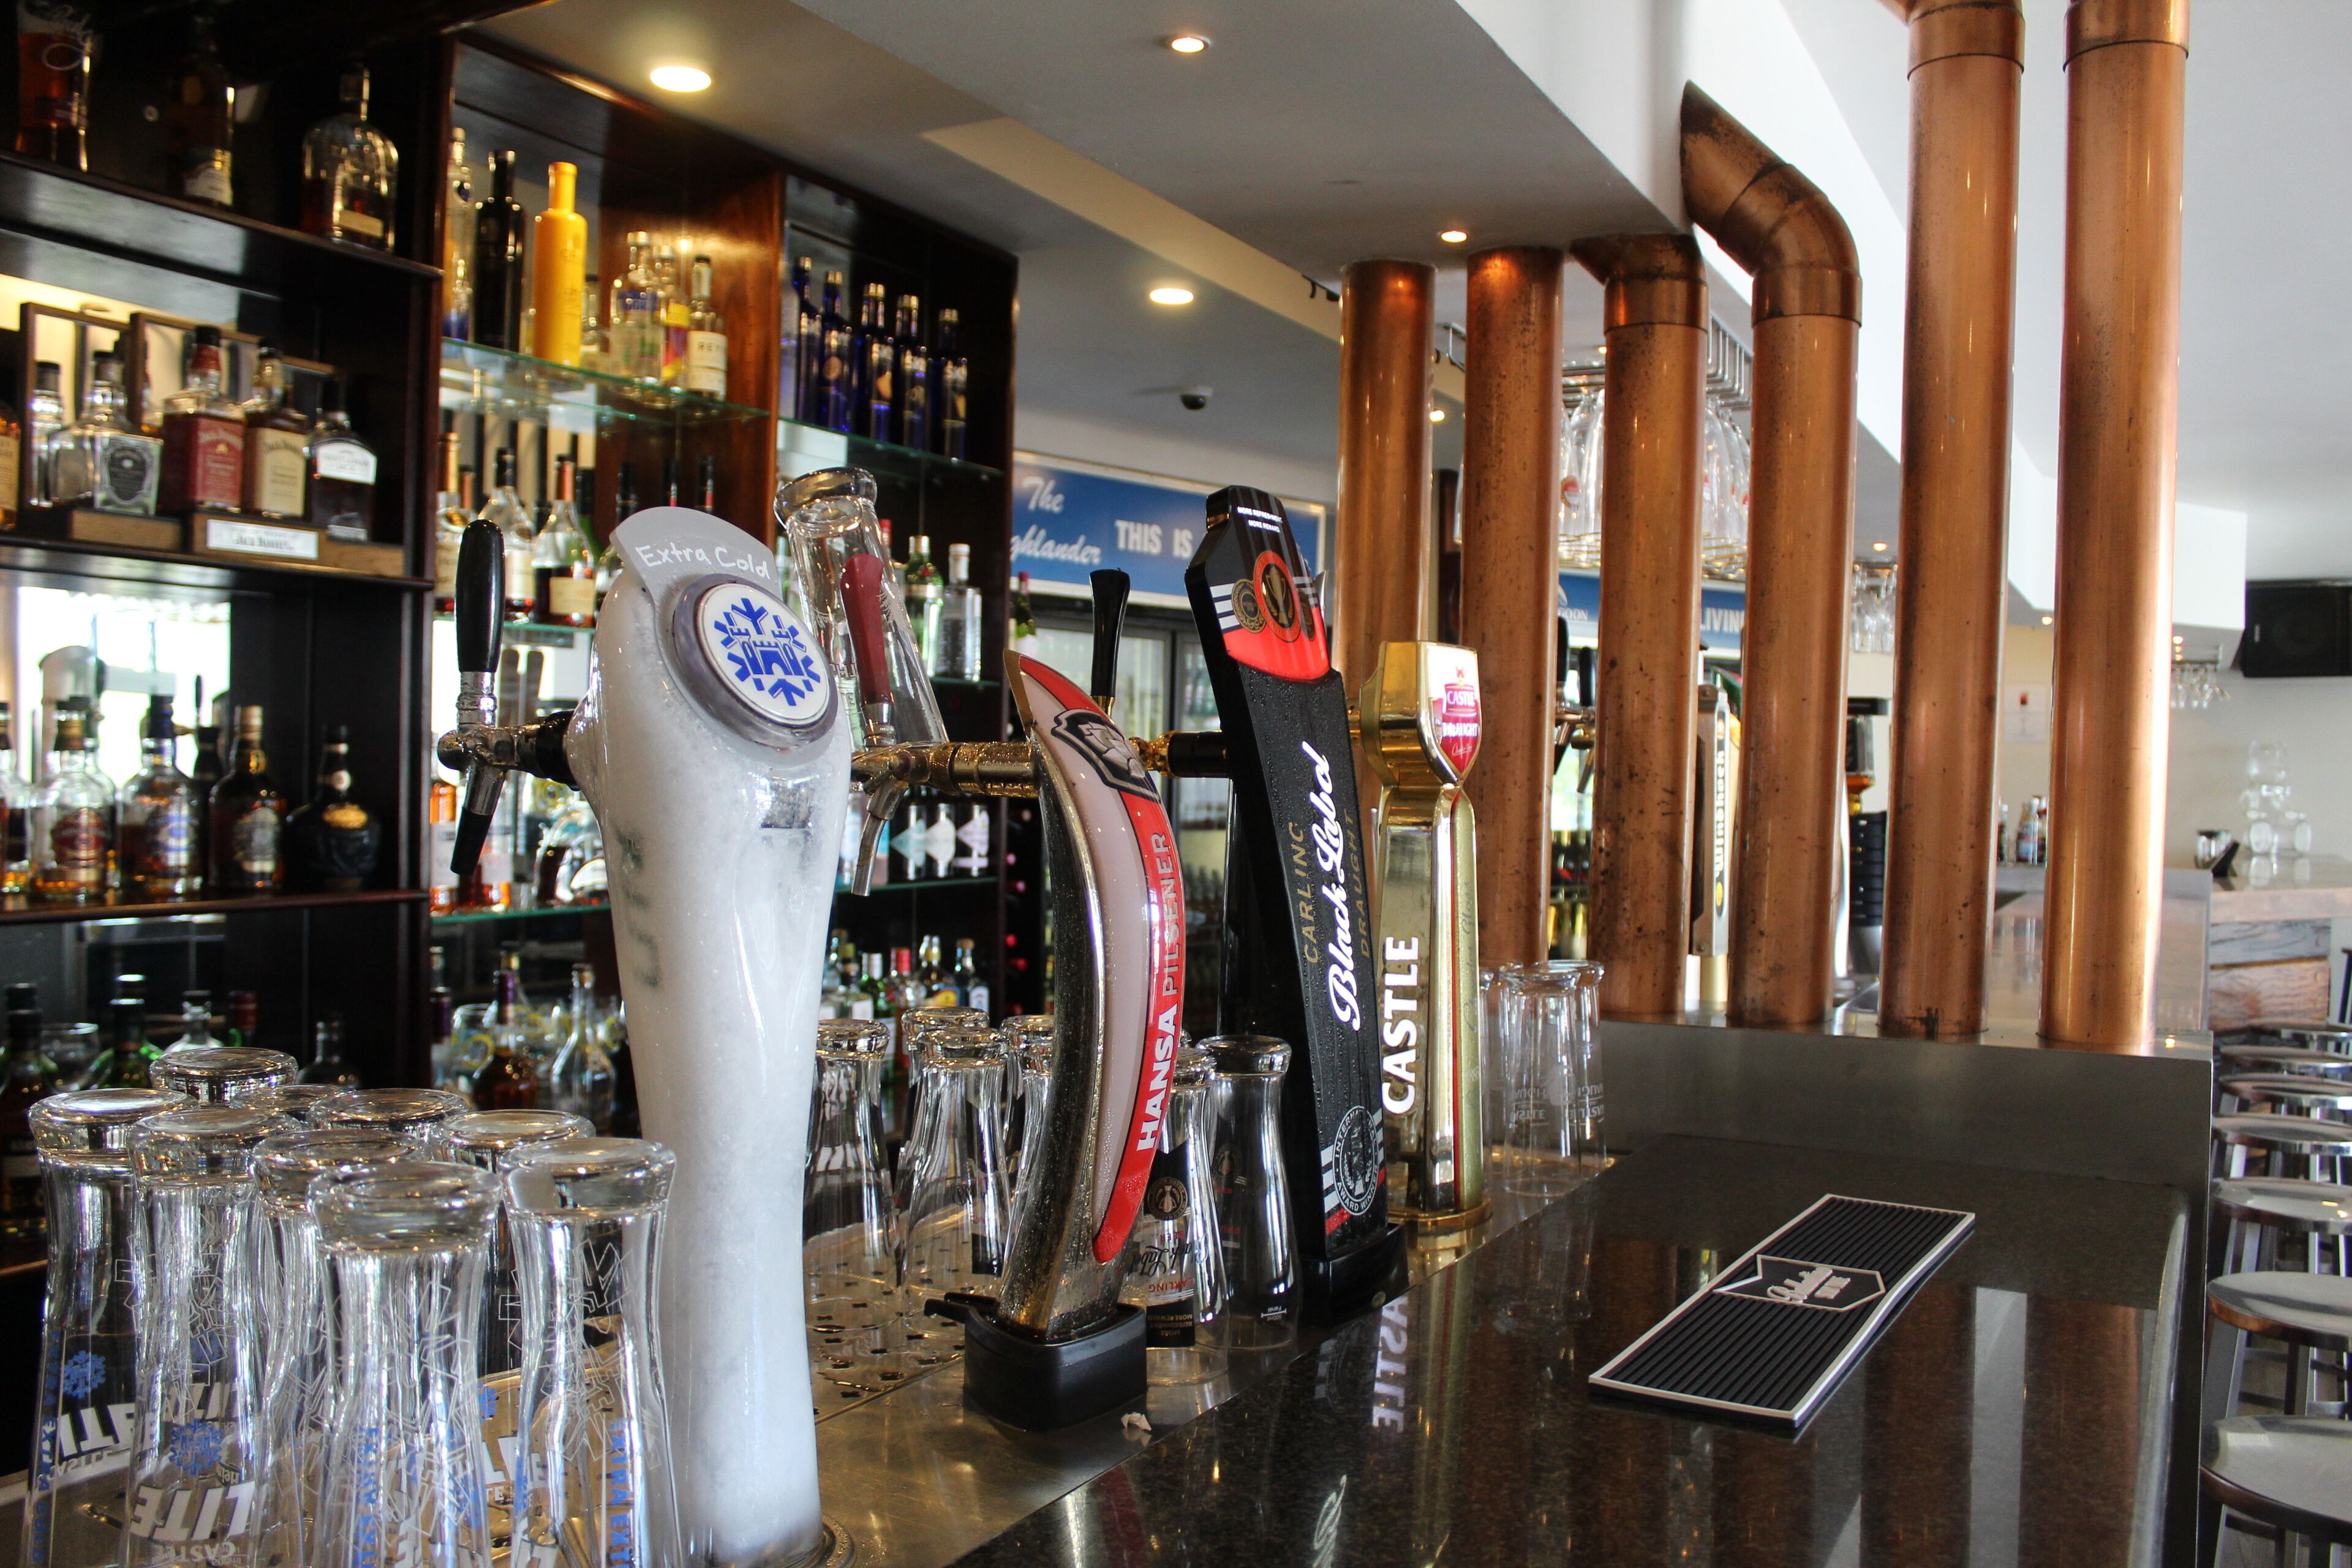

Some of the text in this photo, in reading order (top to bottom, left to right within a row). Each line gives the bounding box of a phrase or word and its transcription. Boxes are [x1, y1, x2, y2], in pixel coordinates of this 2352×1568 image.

[1023, 476, 1065, 513] The
[1237, 506, 1253, 516] MORE
[1115, 518, 1194, 559] THIS IS
[1248, 519, 1263, 529] MORE
[635, 542, 771, 579] Extra Cold
[1010, 524, 1102, 565] ghlander
[1700, 608, 1745, 633] IVIN
[1447, 690, 1475, 706] CASTLE
[1443, 722, 1479, 737] DRAUGHT
[1289, 823, 1318, 963] CARLING
[1302, 741, 1361, 1031] Black Label
[1344, 808, 1370, 958] DRAUGHT
[1137, 832, 1180, 1151] HANSA PILSENER
[1382, 937, 1419, 1115] CASTLE
[1337, 1182, 1359, 1212] AWARD
[1148, 1278, 1194, 1293] CARLING
[129, 1480, 255, 1541] LITE
[609, 1417, 630, 1568] EXTRA EXT
